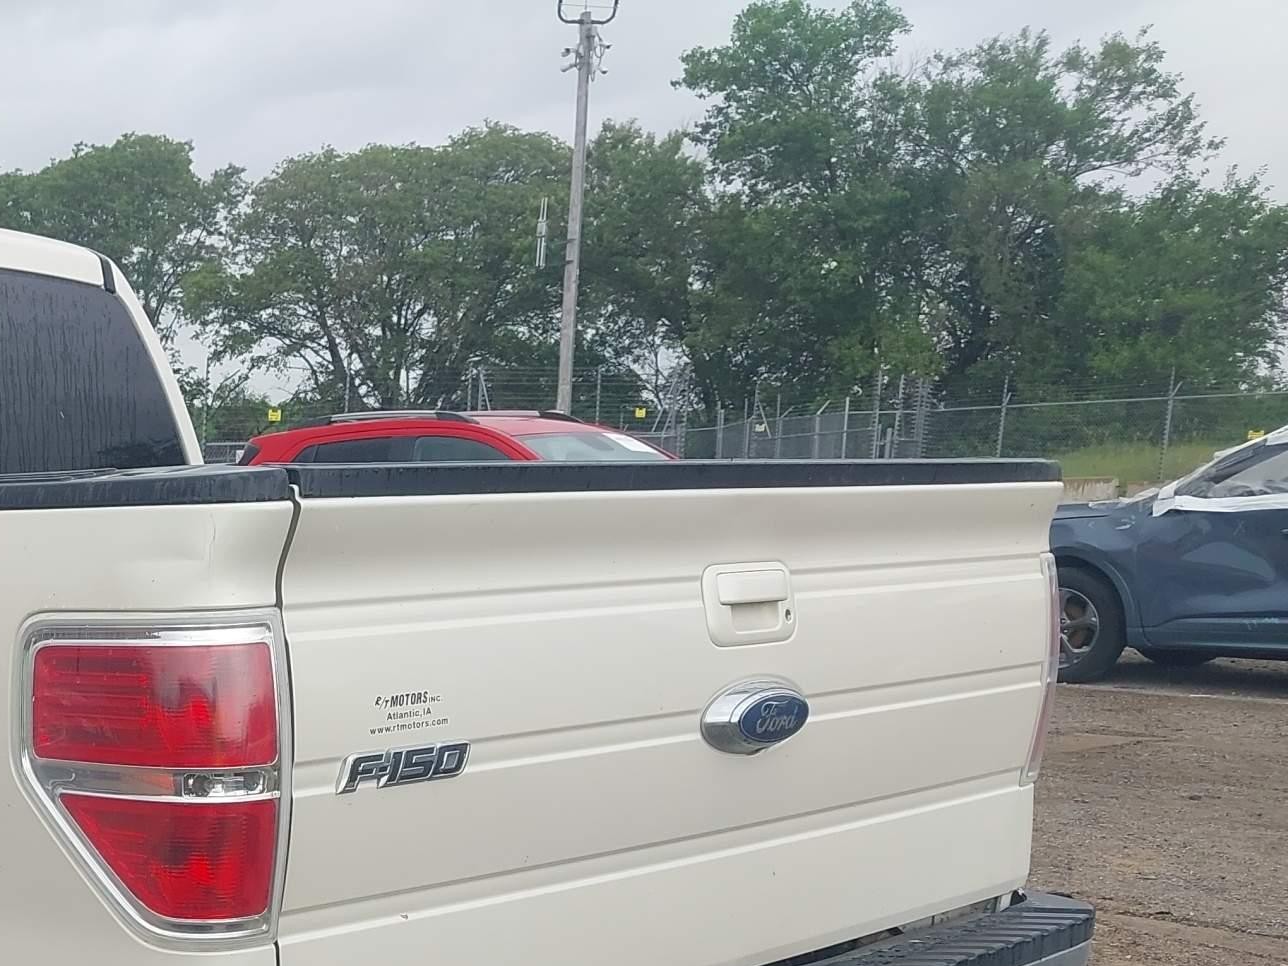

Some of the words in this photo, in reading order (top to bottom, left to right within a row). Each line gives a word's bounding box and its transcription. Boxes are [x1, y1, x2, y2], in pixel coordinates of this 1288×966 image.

[390, 691, 428, 708] MOTORS
[369, 717, 449, 735] www.rtmotors.com
[757, 700, 797, 733] Ford
[339, 741, 470, 793] F-150
